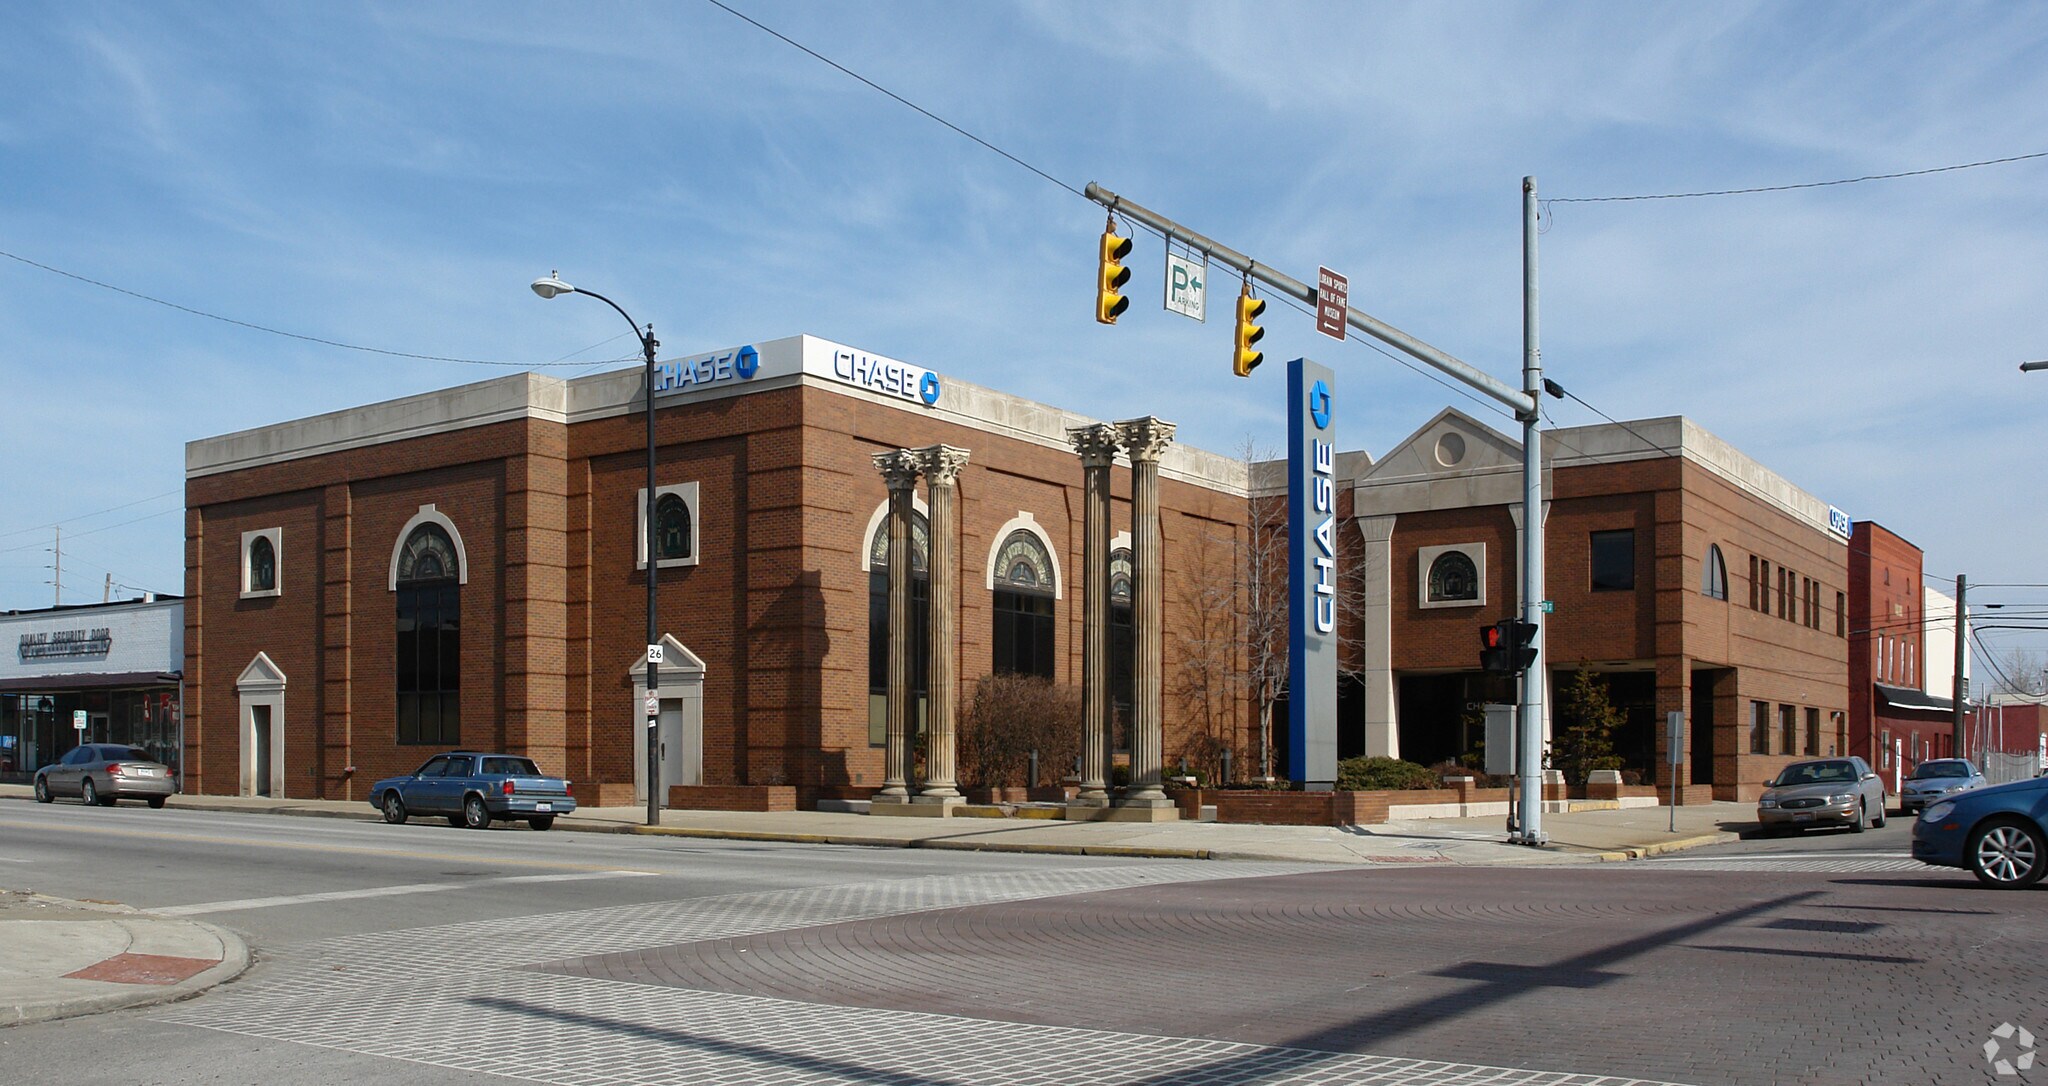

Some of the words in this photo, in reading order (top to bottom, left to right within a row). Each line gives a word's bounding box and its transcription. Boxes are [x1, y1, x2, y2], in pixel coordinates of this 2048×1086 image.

[1319, 273, 1333, 288] LORAIN
[1333, 278, 1347, 294] SPORTS
[1319, 288, 1330, 301] HALL
[1330, 293, 1336, 303] OF
[1336, 295, 1346, 308] FAME
[1324, 305, 1340, 321] MUSEUM
[834, 349, 915, 398] CHASE
[1313, 438, 1334, 633] CHASE
[20, 633, 47, 645] QUALITY
[53, 630, 86, 643] SECURITY
[91, 628, 110, 639] DOOR
[649, 648, 662, 659] 26
